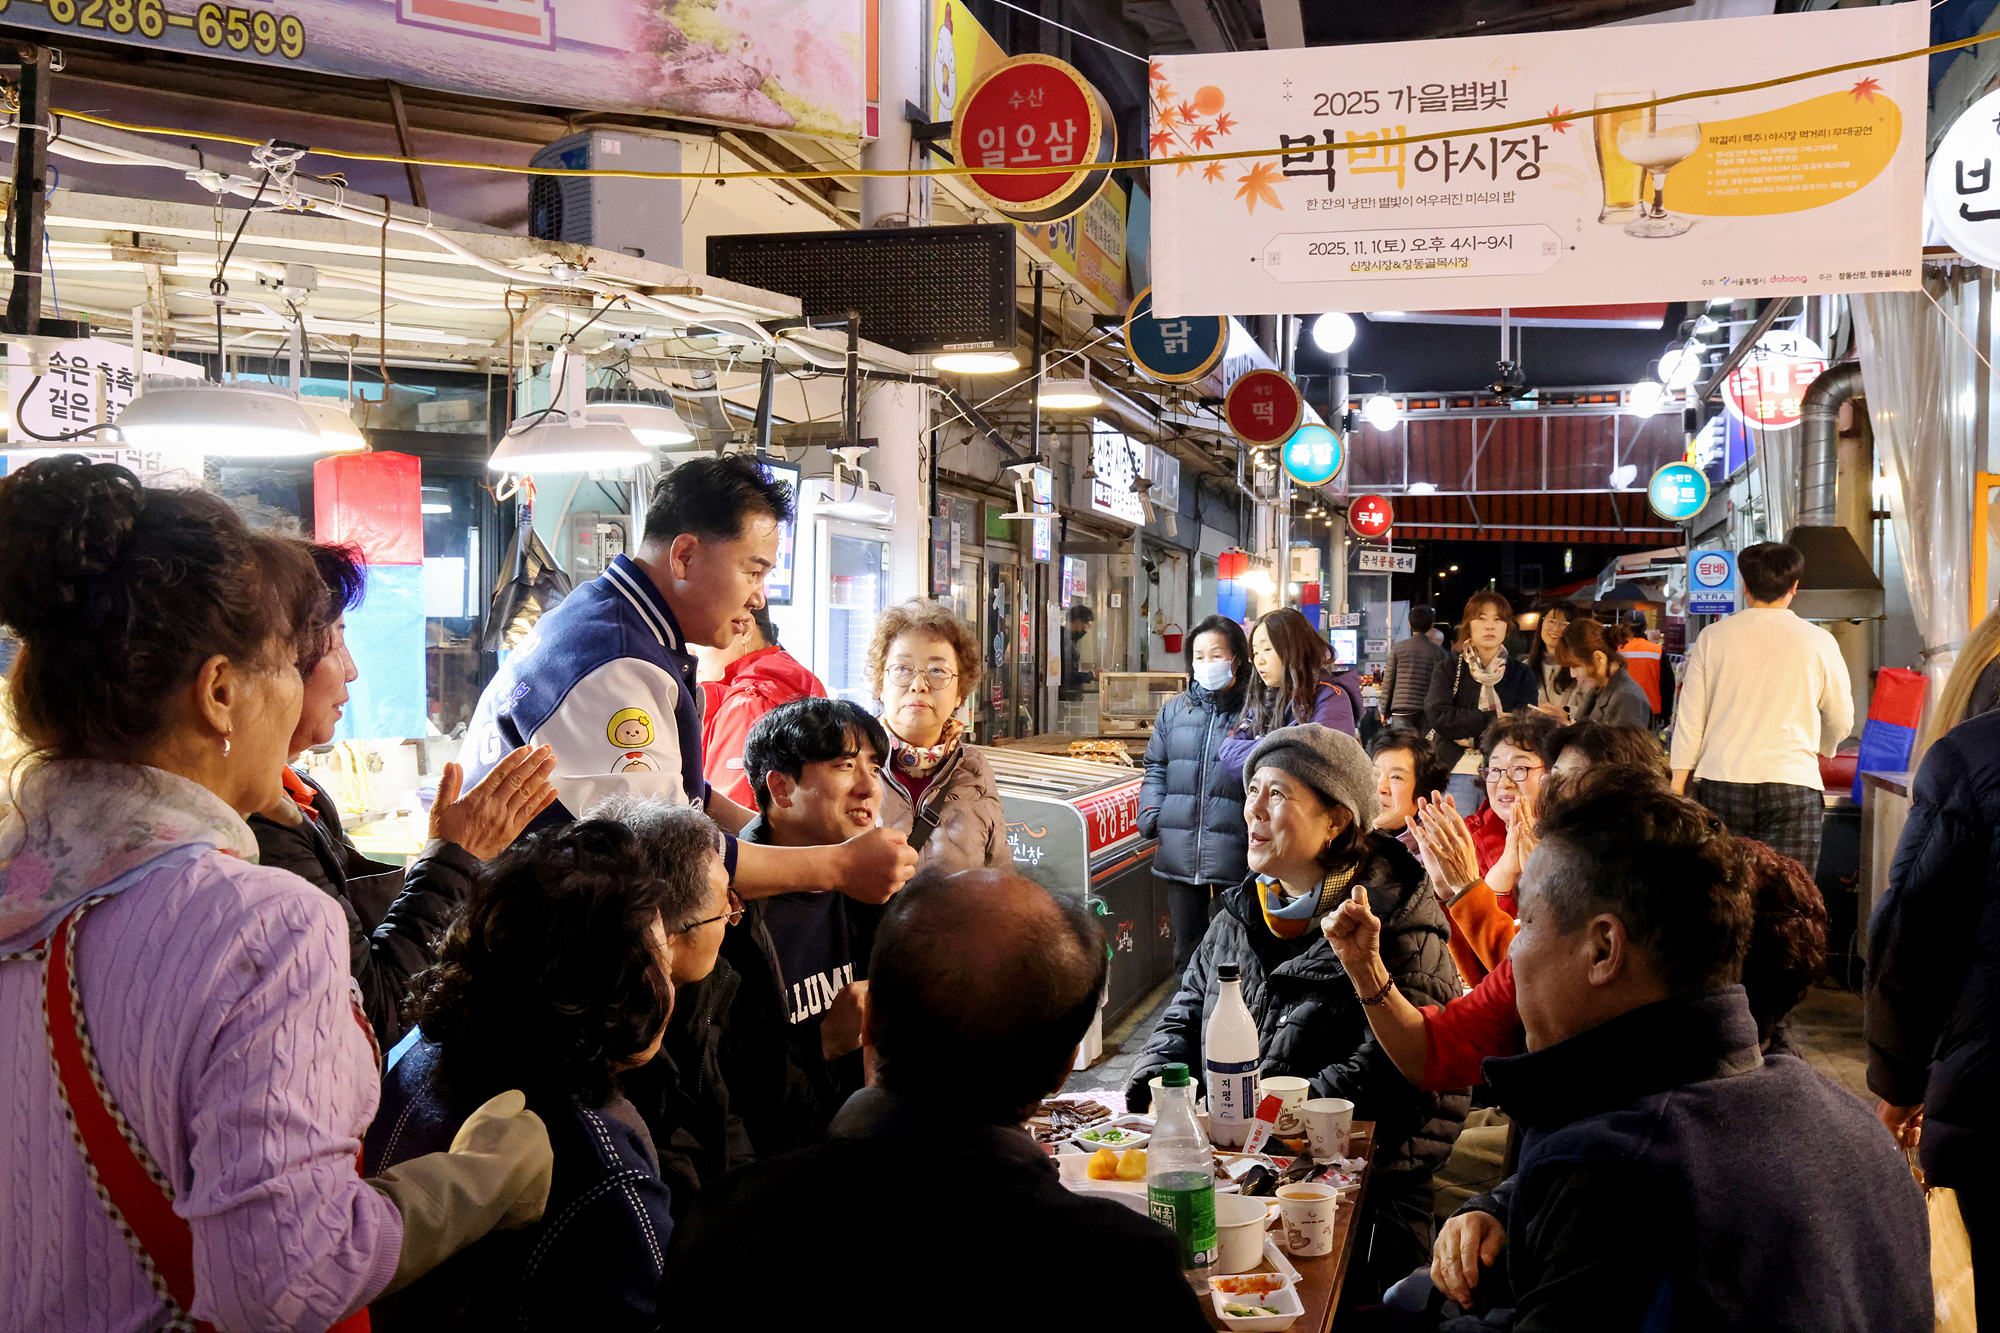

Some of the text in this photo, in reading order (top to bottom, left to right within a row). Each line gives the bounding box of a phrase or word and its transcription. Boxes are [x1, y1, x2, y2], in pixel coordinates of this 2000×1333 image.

[1008, 87, 1044, 109] 수산
[1313, 79, 1508, 117] 2025 가을별빛
[977, 118, 1077, 168] 일오삼
[1709, 126, 1873, 145] 막걸리 맥주 야시장 먹거리 무대공연
[1414, 135, 1548, 183] 야시장
[1306, 190, 1516, 211] 한 잔의 낭만! 별빛이 어우러진 미식의 밤
[1308, 233, 1514, 256] 2025. 11. 1(토) 오후 4시~9시
[1349, 256, 1469, 273] 신창시장&창동골목시장
[1730, 277, 1766, 287] 서울특별시
[1769, 275, 1808, 284] dobong
[1159, 321, 1192, 354] 닭
[49, 351, 91, 387] 속은
[1731, 360, 1824, 396] 순대국
[49, 387, 91, 423] 겉은
[1251, 401, 1274, 426] 떡
[1755, 398, 1802, 419] 곱창
[1291, 443, 1334, 465] 족발
[1661, 486, 1697, 504] 마트
[1357, 512, 1384, 527] 두부
[1699, 563, 1726, 575] 담배
[790, 963, 853, 1024] LUM
[1221, 1078, 1232, 1102] 지평
[1152, 1206, 1173, 1220] 서울
